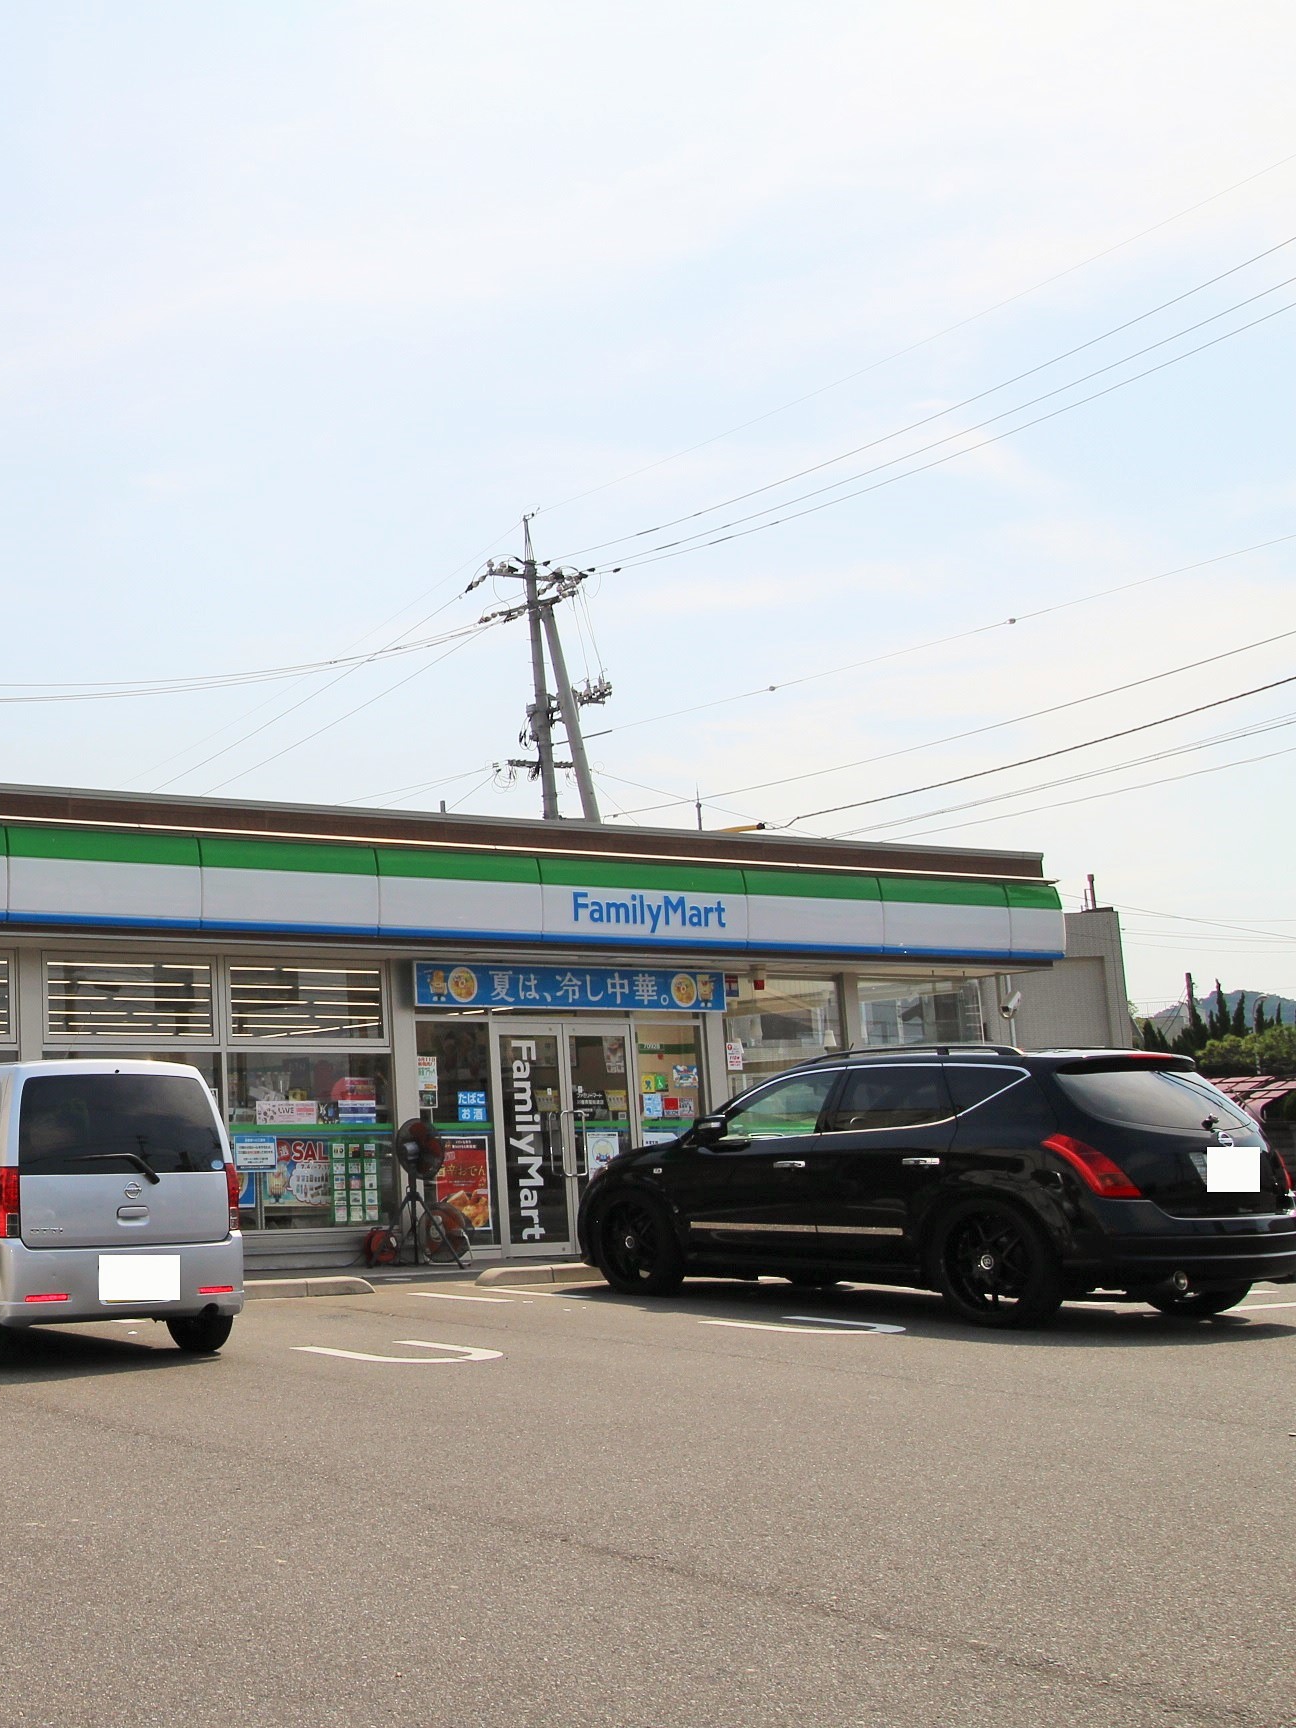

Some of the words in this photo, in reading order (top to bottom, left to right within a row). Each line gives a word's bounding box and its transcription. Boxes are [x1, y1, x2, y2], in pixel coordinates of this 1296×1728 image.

[572, 891, 726, 934] FamilyMart
[489, 970, 669, 1005] 夏は、冷し中華。
[458, 1092, 486, 1104] たばこ
[461, 1108, 484, 1120] お酒
[291, 1141, 329, 1161] SAL
[510, 1040, 546, 1240] FamilyMart
